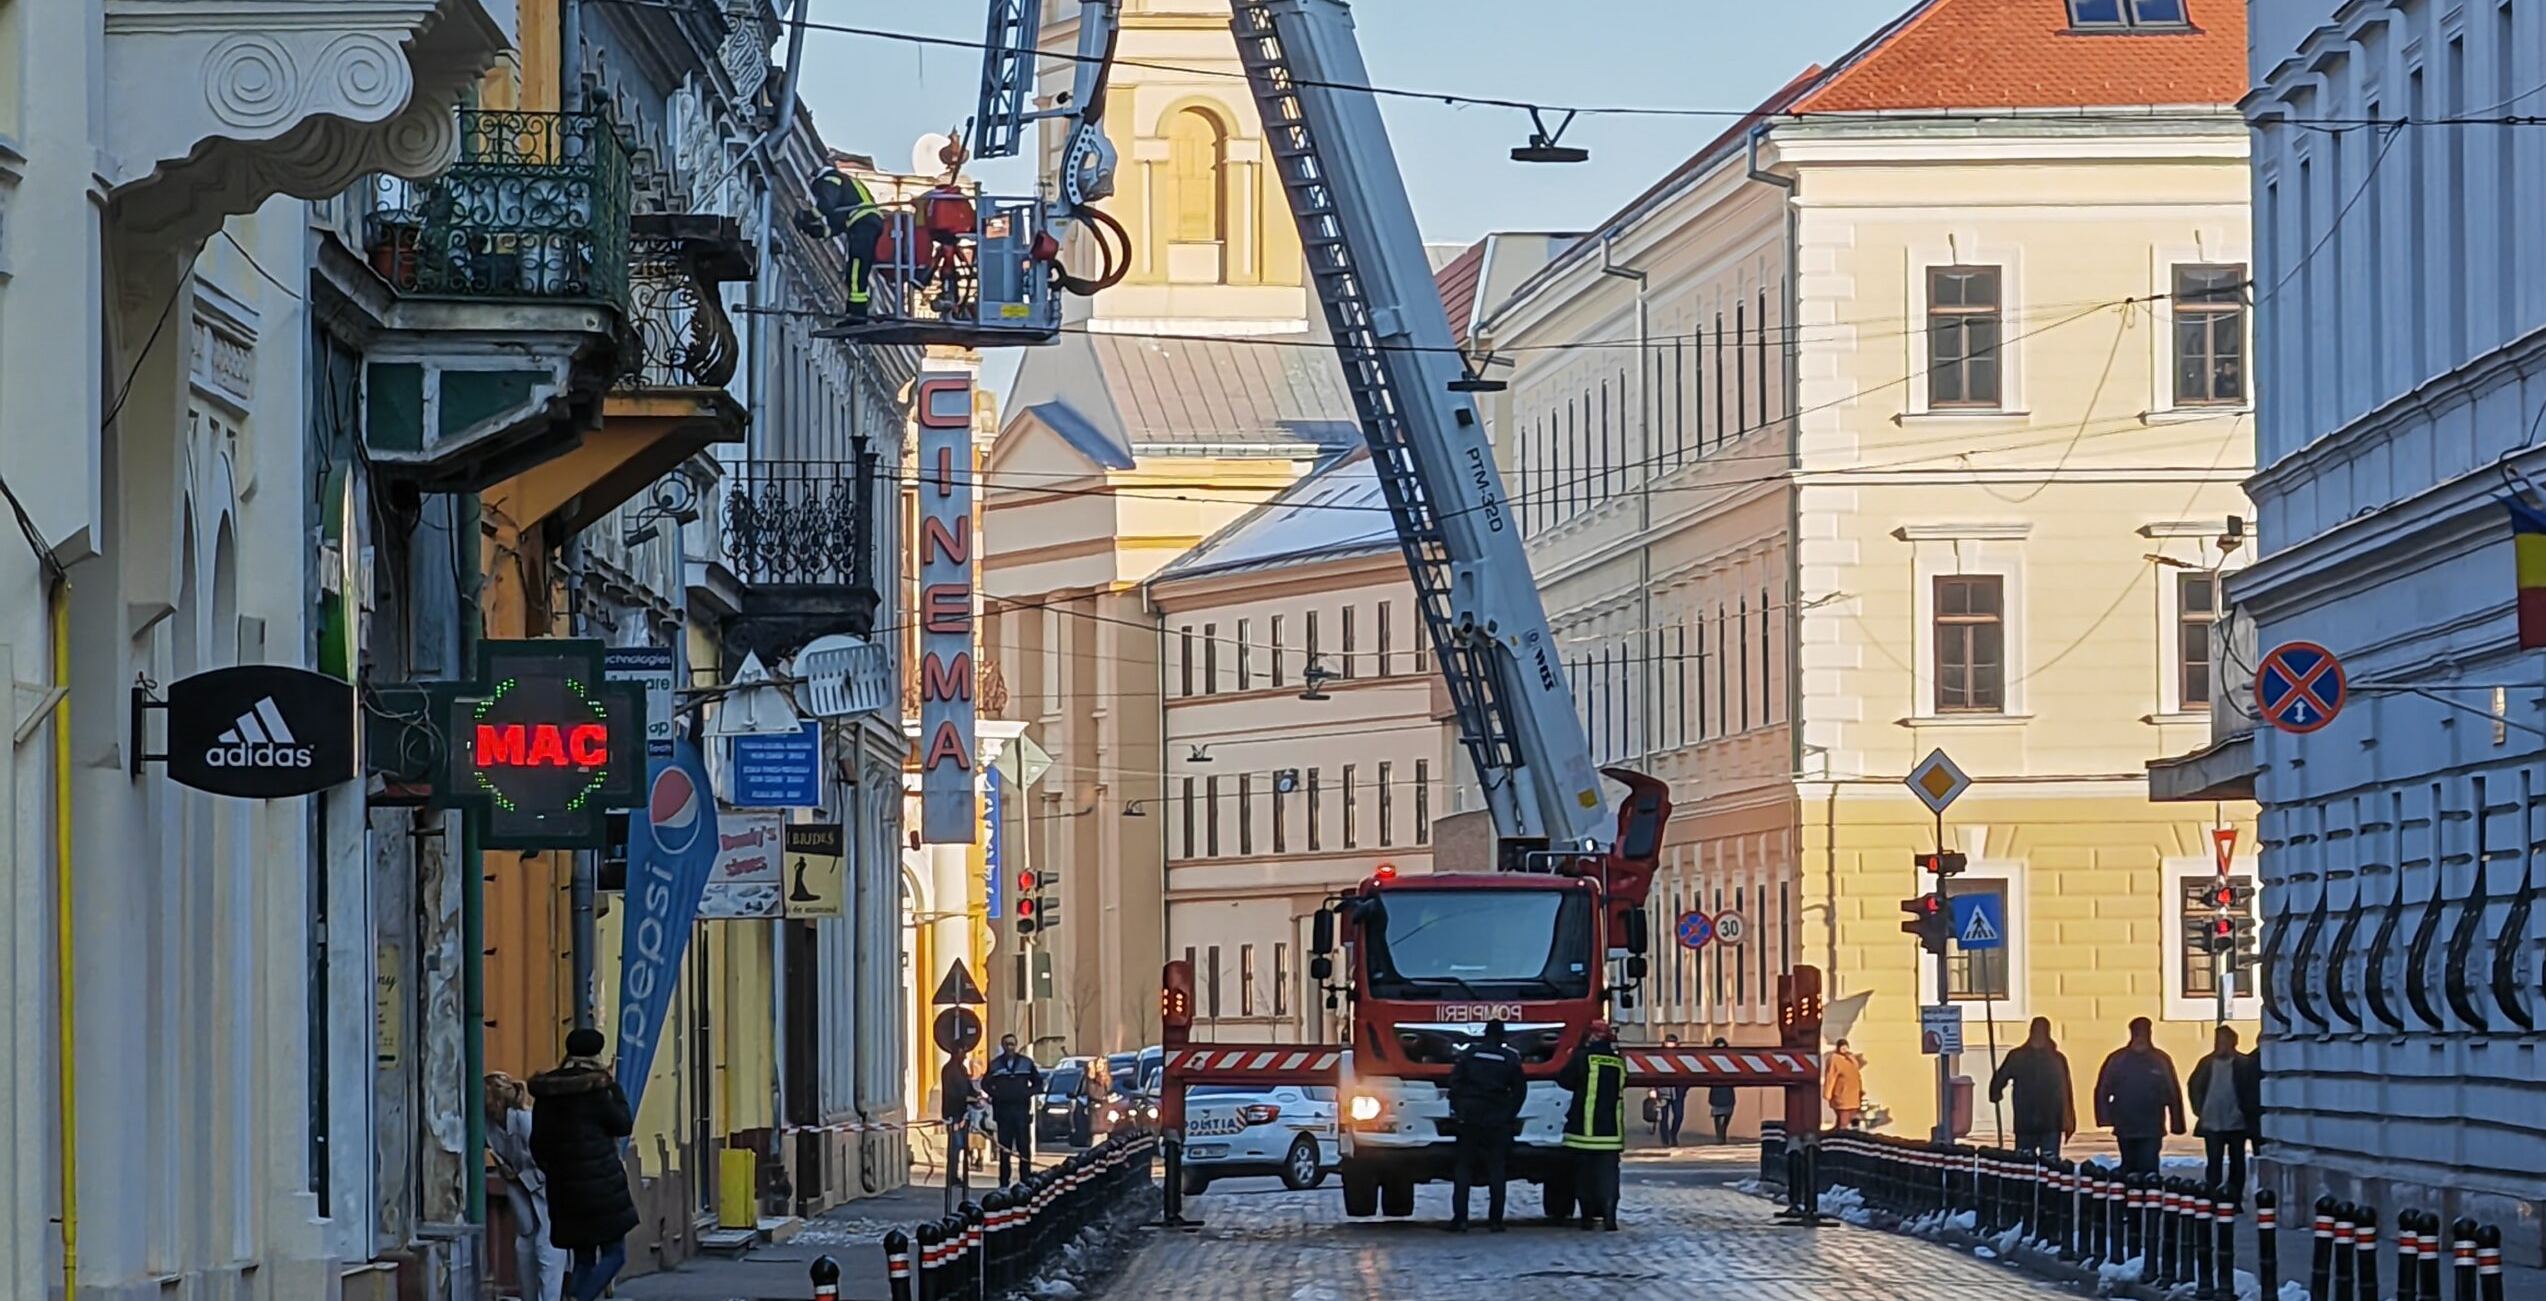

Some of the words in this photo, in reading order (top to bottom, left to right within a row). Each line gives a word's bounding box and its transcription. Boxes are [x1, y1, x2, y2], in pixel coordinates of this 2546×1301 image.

[918, 378, 971, 771] CINEMA
[205, 741, 313, 768] adidas
[621, 861, 673, 1049] pepsi
[1720, 919, 1739, 937] 30
